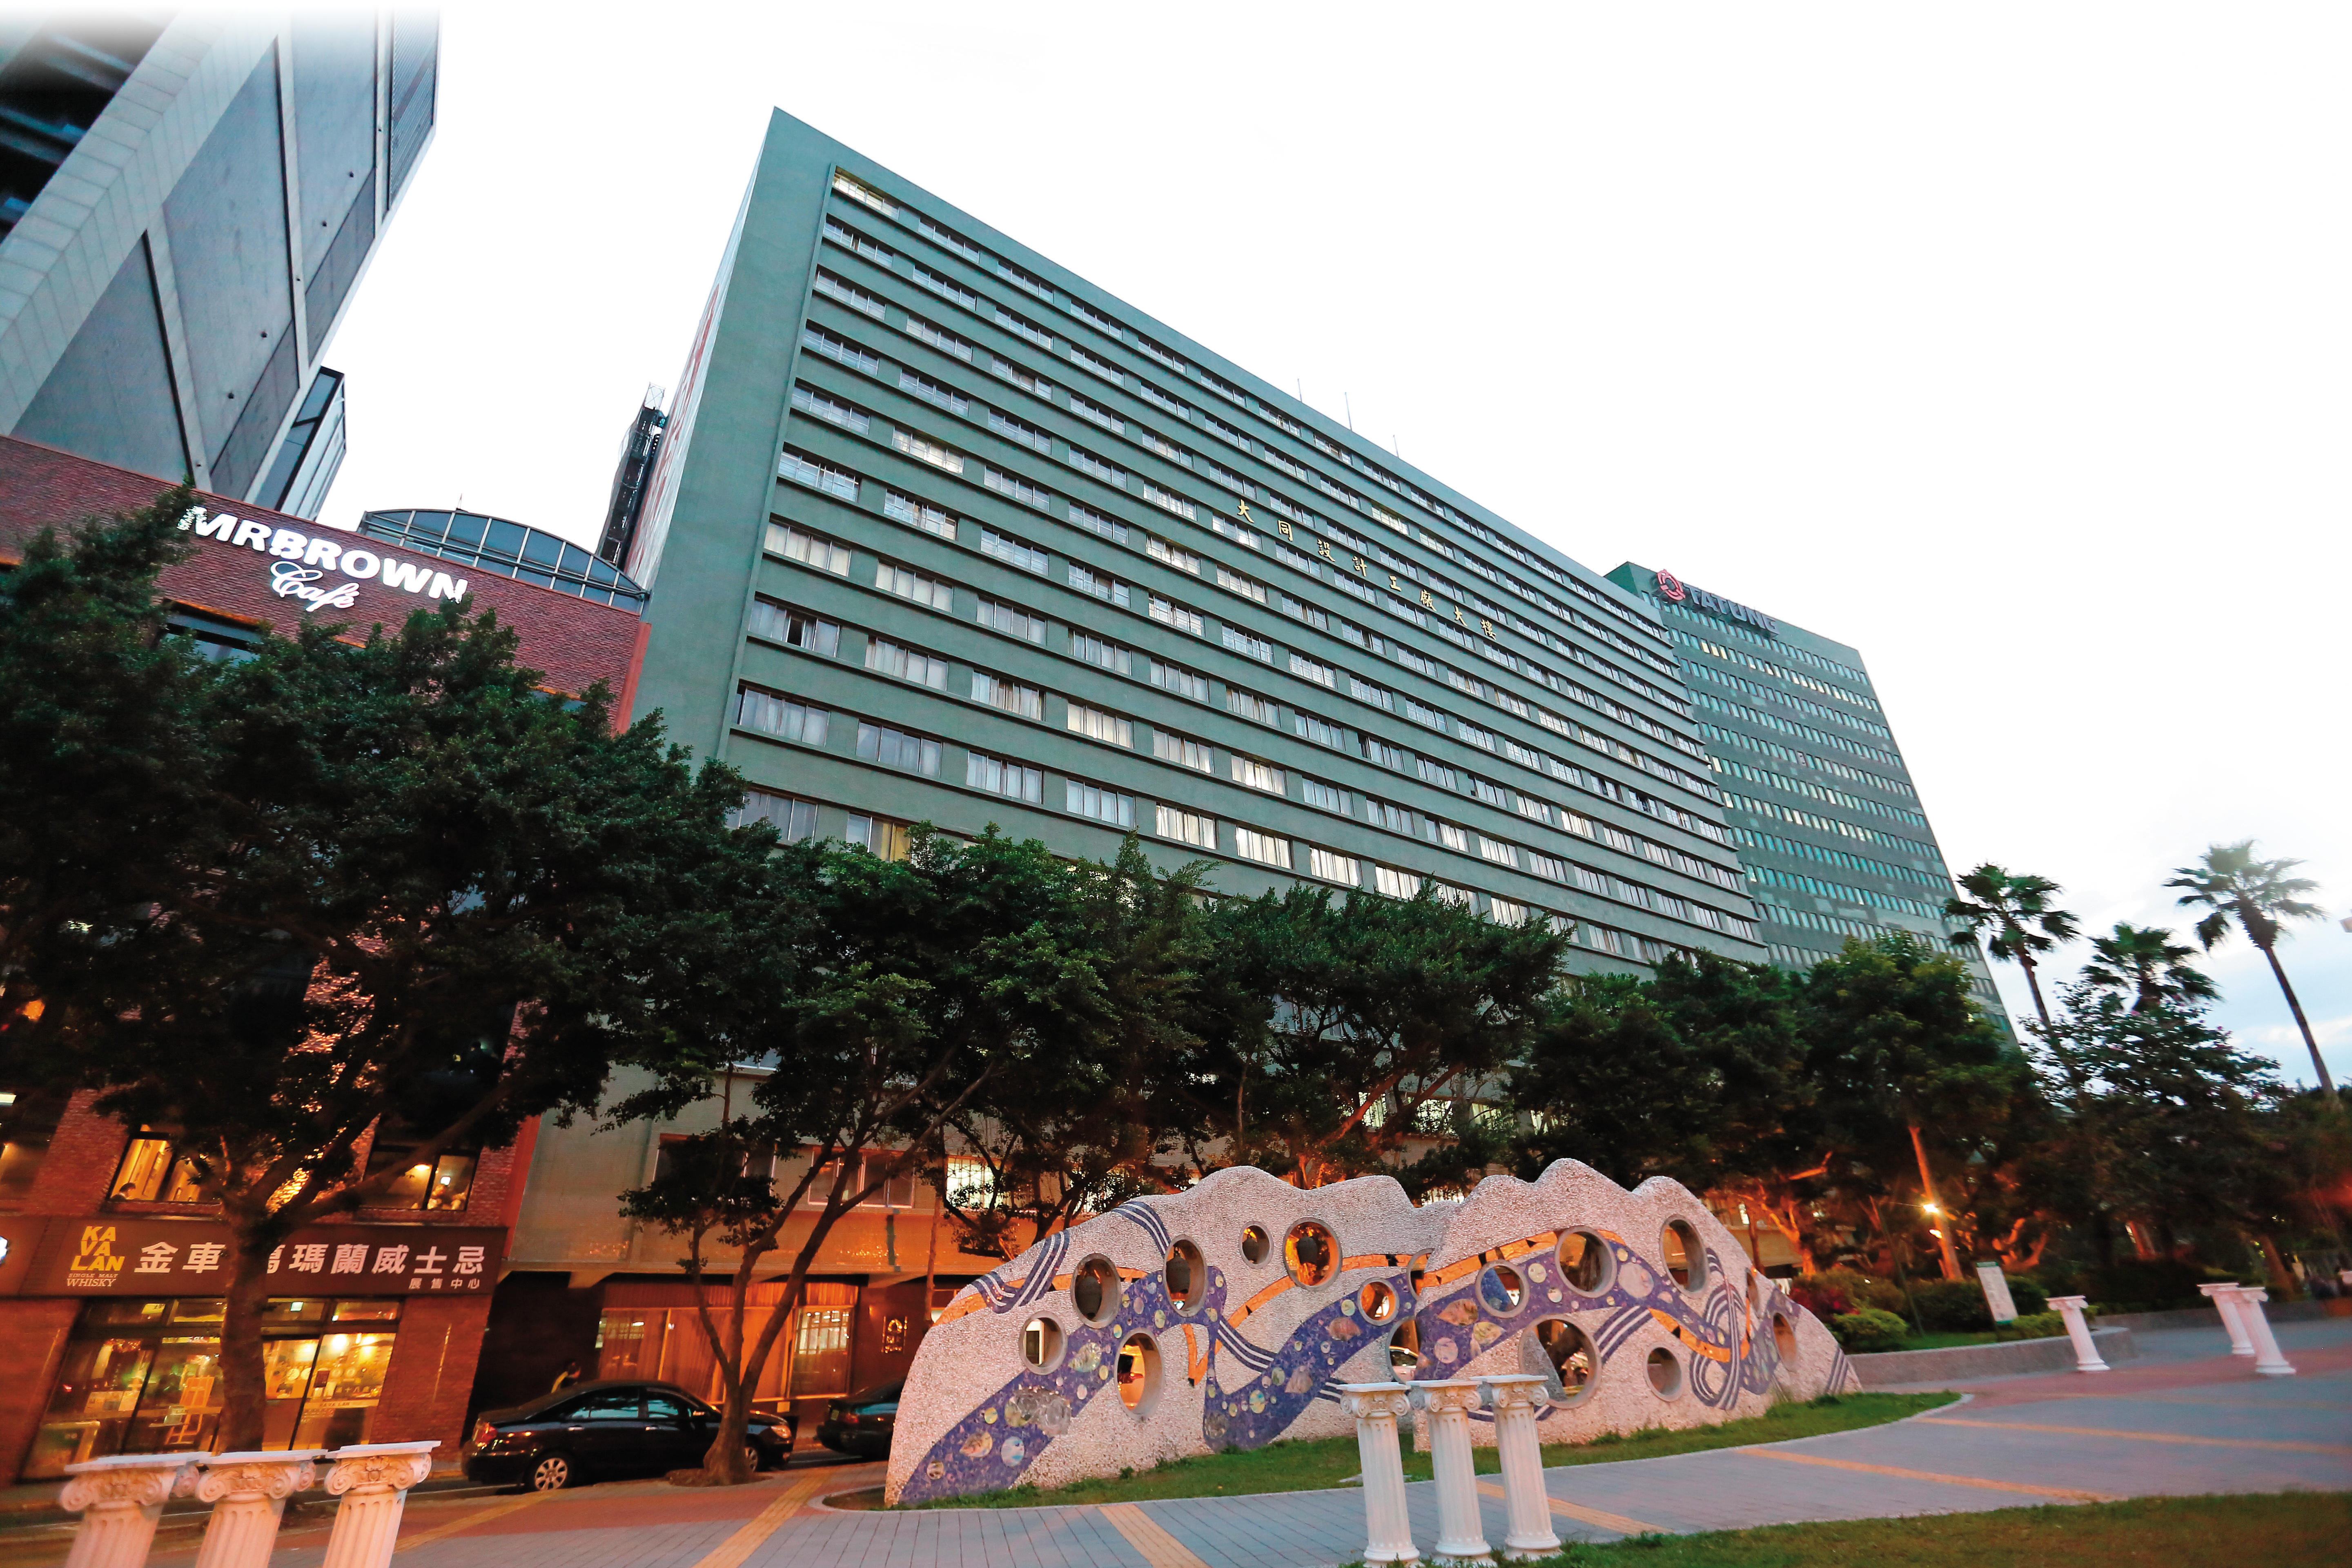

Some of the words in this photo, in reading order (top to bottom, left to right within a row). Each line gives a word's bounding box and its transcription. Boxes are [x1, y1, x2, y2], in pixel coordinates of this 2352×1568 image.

[1237, 499, 1497, 641] 大同設計工廠大樓
[270, 561, 360, 612] Café
[1682, 583, 1780, 635] TATUNG
[82, 1226, 116, 1241] KA
[81, 1241, 110, 1256] VA
[70, 1255, 125, 1271] LAN
[67, 1278, 116, 1287] WHISKY
